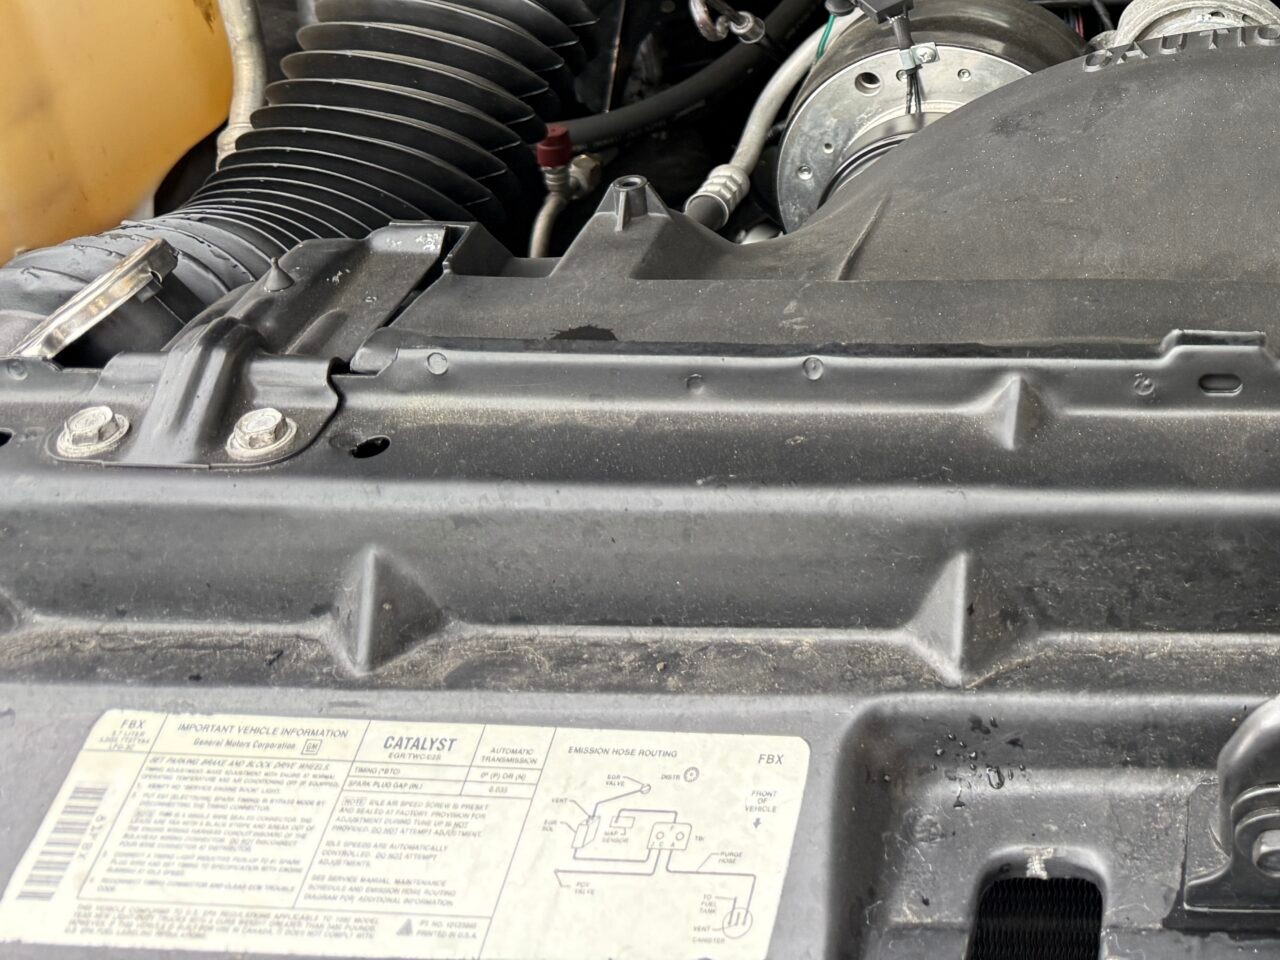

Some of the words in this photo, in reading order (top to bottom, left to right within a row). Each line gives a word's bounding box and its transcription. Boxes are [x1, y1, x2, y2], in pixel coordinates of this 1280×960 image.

[120, 720, 146, 729] FBX
[178, 723, 234, 734] IMPORTANT
[238, 726, 279, 736] VEHICLE
[281, 728, 348, 738] INFORMATION
[193, 738, 223, 747] General
[225, 739, 250, 748] Motors
[252, 740, 296, 750] Corporation
[383, 736, 457, 751] CATALYST
[490, 747, 534, 755] AUTOMATIC
[568, 746, 610, 756] EMISSION
[612, 748, 637, 757] HOSE
[638, 749, 678, 759] ROUTING
[481, 755, 537, 764] TRANSMISSION
[758, 754, 784, 765] FBX
[354, 766, 377, 774] TIMING
[502, 772, 514, 780] OR
[348, 780, 371, 788] SPARK
[372, 781, 392, 789] PLUG
[393, 782, 408, 790] GAP
[751, 790, 778, 798] FRONT
[745, 805, 777, 813] VEHICLE
[389, 843, 449, 852] AUTOMATICALLY
